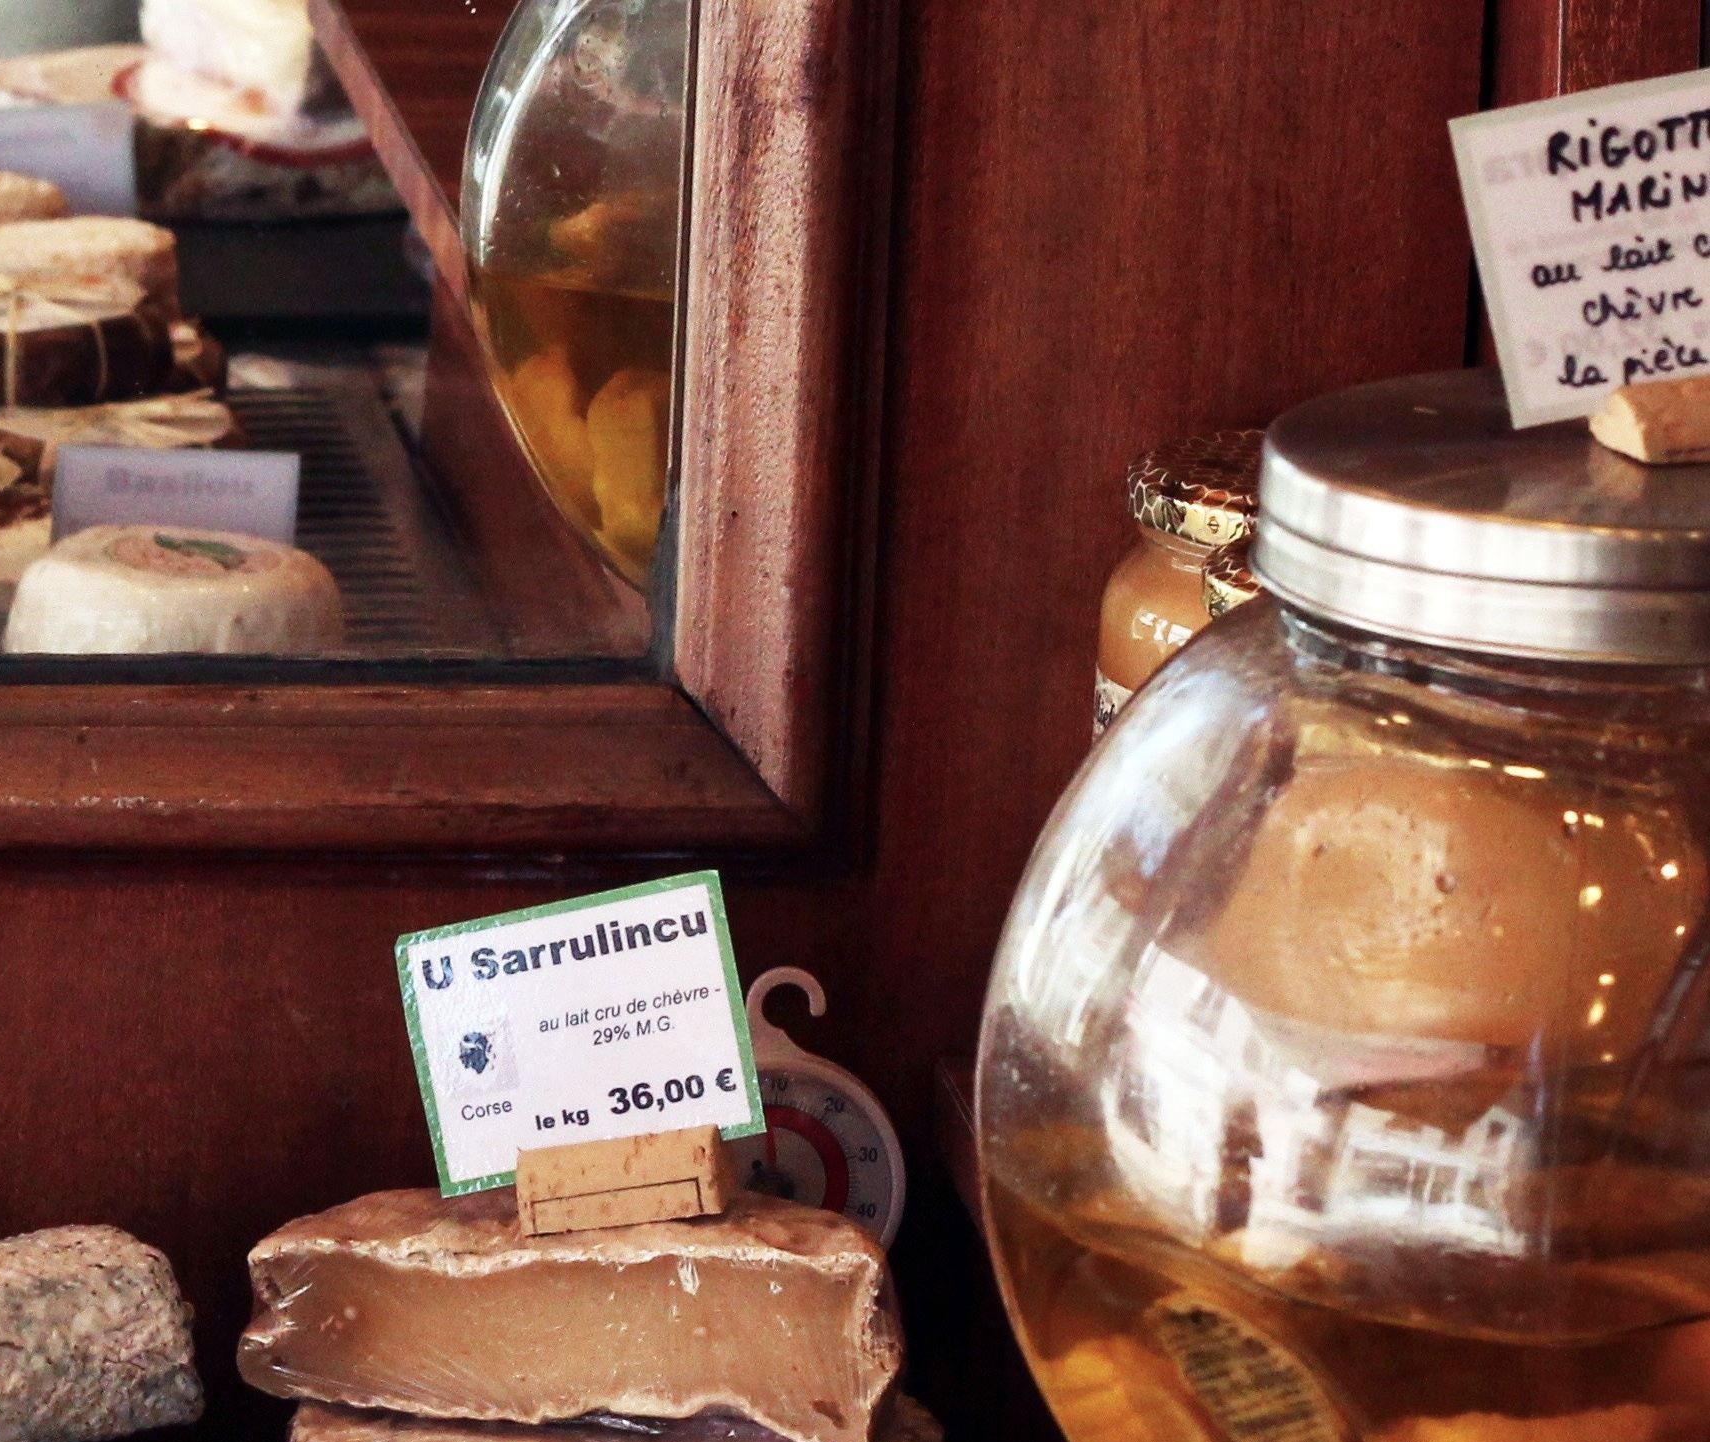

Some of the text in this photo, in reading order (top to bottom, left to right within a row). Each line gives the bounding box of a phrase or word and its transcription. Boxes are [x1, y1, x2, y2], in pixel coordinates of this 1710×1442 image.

[1531, 262, 1581, 288] au
[1602, 236, 1675, 272] lait
[1582, 286, 1703, 327] chèvre
[1558, 354, 1608, 388] la
[421, 910, 708, 990] U Sarrulincu
[539, 1017, 562, 1034] au
[565, 1009, 590, 1028] lait
[595, 1006, 622, 1024] cru
[626, 998, 648, 1016] de
[652, 985, 710, 1011] chèvre
[593, 1027, 631, 1048] 29%
[461, 1098, 513, 1122] Corse
[535, 1067, 738, 1132] le kg 36,00 €
[857, 1147, 879, 1163] 30
[855, 1202, 877, 1219] 40
